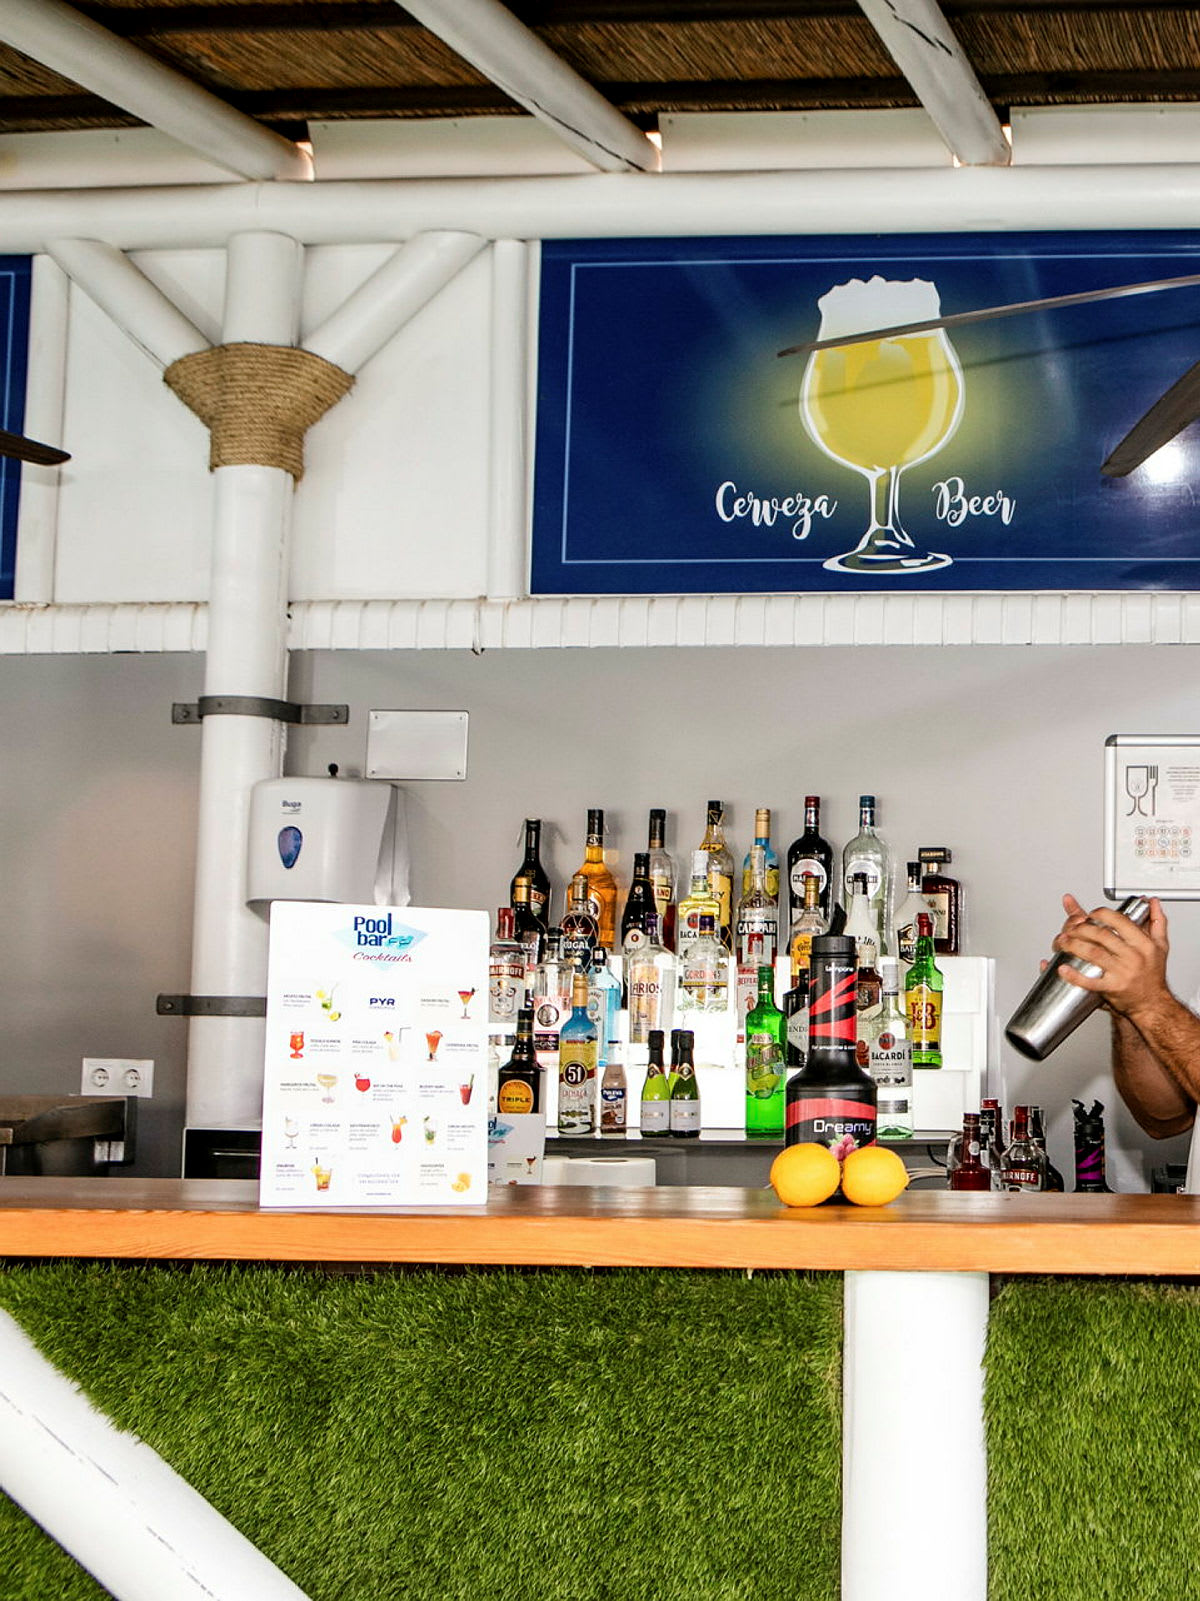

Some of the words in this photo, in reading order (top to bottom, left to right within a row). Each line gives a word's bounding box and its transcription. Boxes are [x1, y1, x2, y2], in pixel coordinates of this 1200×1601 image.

[715, 481, 838, 540] Cerveza
[931, 477, 1016, 527] Beer
[354, 912, 392, 936] Pool
[738, 921, 776, 934] CAMPARI
[357, 930, 387, 947] bar
[353, 951, 412, 963] Cocktails
[369, 997, 395, 1006] PYR
[567, 1066, 582, 1083] 51
[813, 1120, 872, 1135] Dreamy
